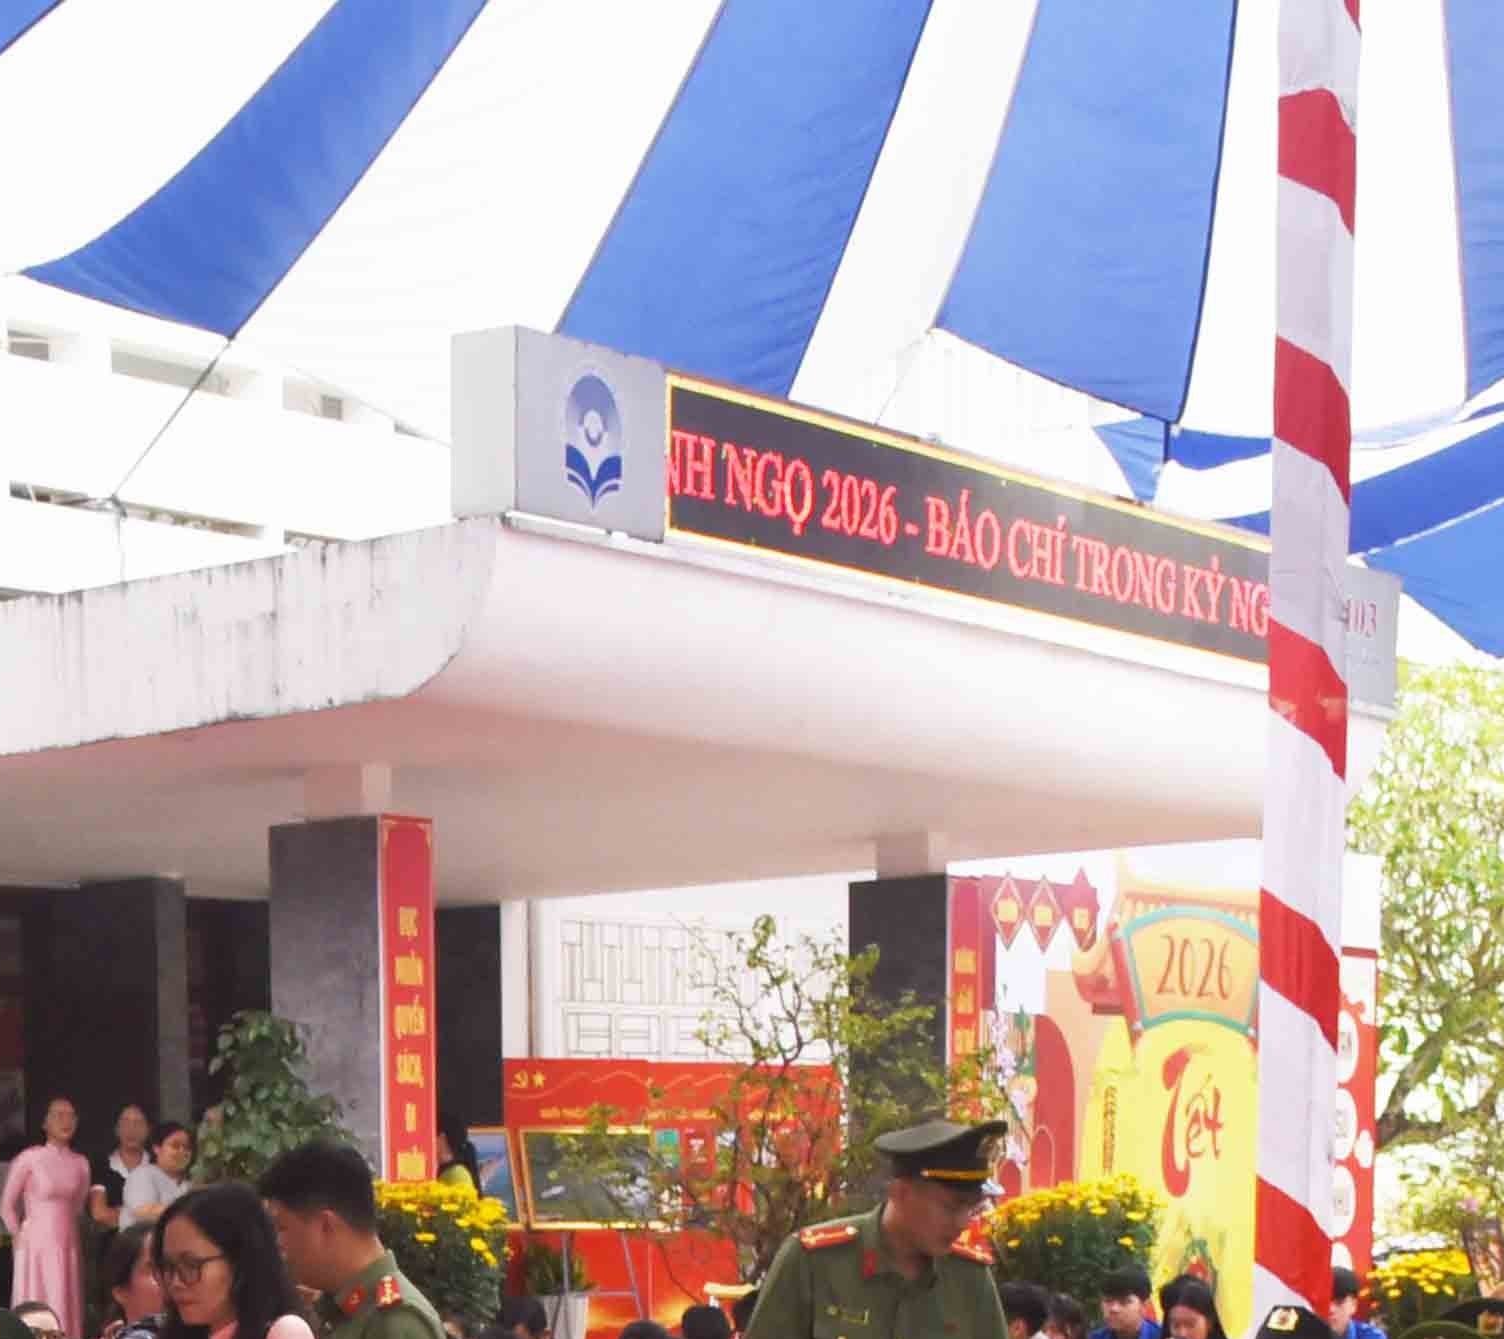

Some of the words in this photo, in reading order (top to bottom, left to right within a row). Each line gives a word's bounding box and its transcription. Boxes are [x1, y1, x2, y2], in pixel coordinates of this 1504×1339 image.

[722, 442, 816, 536] NGỌ
[821, 473, 897, 546] 2026
[925, 482, 1002, 569] BÁO
[1007, 514, 1066, 586] CHÍ
[1072, 535, 1178, 617] TRONG
[1156, 934, 1232, 1001] 2026
[1160, 1044, 1224, 1198] Tết
